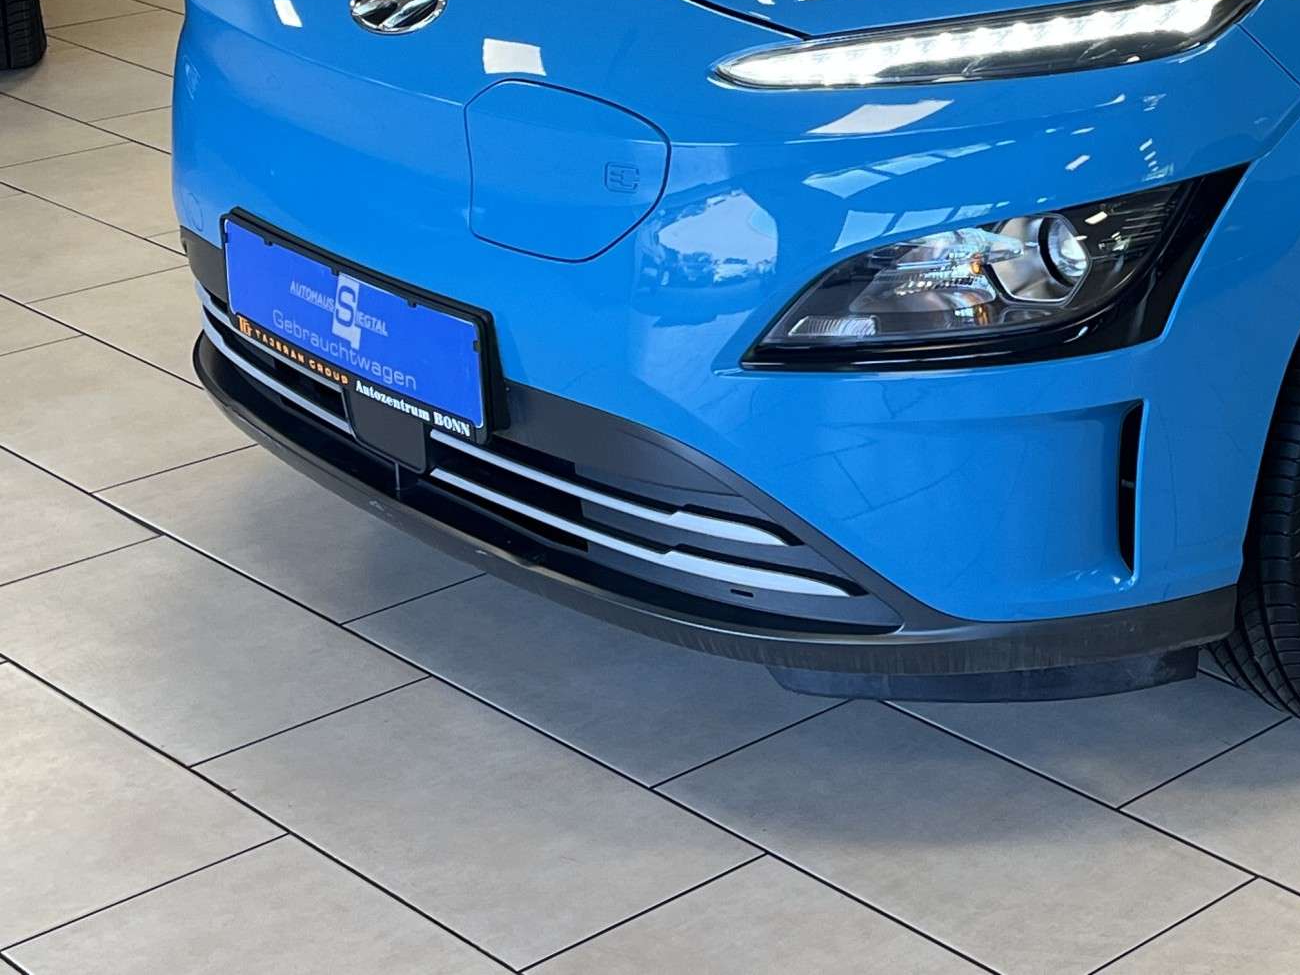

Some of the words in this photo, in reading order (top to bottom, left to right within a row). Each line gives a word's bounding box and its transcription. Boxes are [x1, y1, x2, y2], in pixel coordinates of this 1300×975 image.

[289, 280, 336, 313] AUTOHAUS
[272, 309, 416, 391] Gebrauchtwagen
[308, 358, 349, 385] GROUP
[355, 380, 431, 422] Autozentrum
[433, 411, 471, 437] BONN
